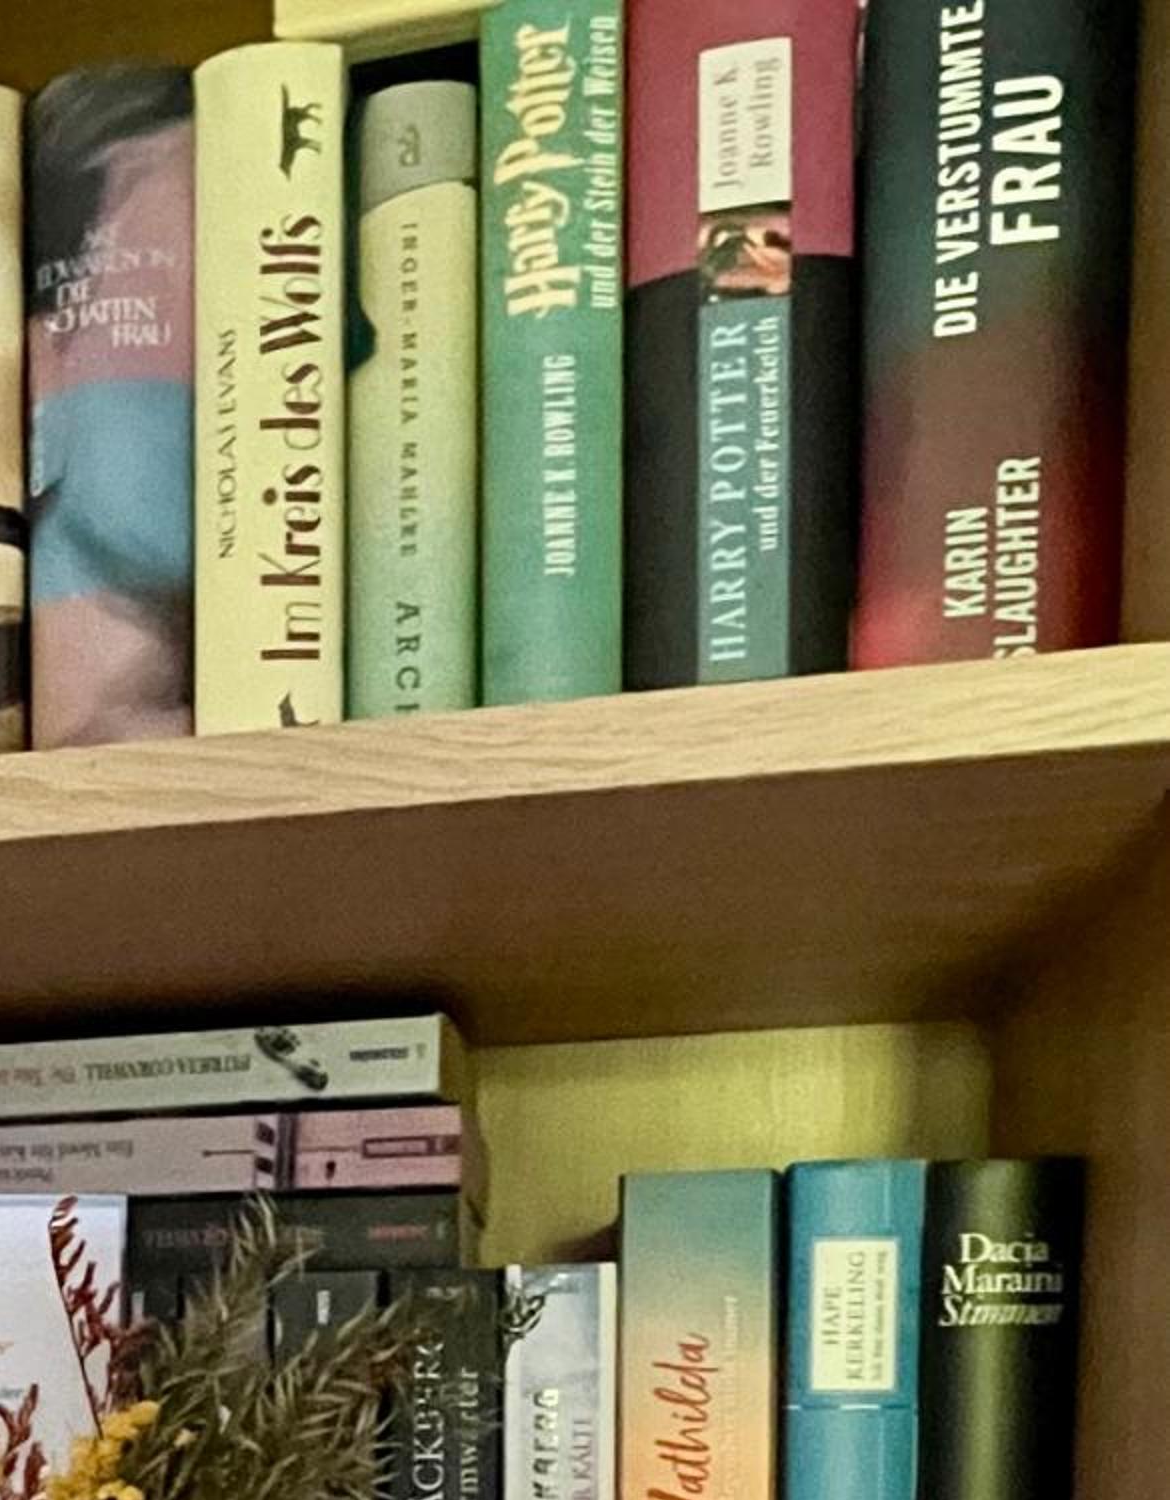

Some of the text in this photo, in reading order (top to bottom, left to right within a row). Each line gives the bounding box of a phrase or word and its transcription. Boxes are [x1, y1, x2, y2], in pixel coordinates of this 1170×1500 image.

[494, 18, 584, 318] Harry Potter
[581, 15, 619, 309] und der Stein der Weisen
[713, 90, 742, 190] Joanne
[750, 55, 780, 169] Rowling
[932, 0, 988, 339] DIE VERSTUMMTE
[987, 73, 1066, 247] FRAU
[258, 213, 325, 661] Im Kreis des Wolfs
[399, 221, 420, 557] INGER-MARIA MAHLKE
[542, 353, 578, 578] JOANNE ROWLING
[752, 314, 781, 552] und der Feuerkelch
[709, 321, 749, 663] HARRY POTTER
[942, 505, 989, 620] KARIN
[993, 455, 1042, 660] SLAUGHTER
[394, 600, 422, 713] ARC
[823, 1285, 843, 1348] HAPE
[845, 1250, 867, 1382] KERKELING
[940, 1262, 1065, 1297] Maraini
[958, 1232, 1051, 1264] Dacia
